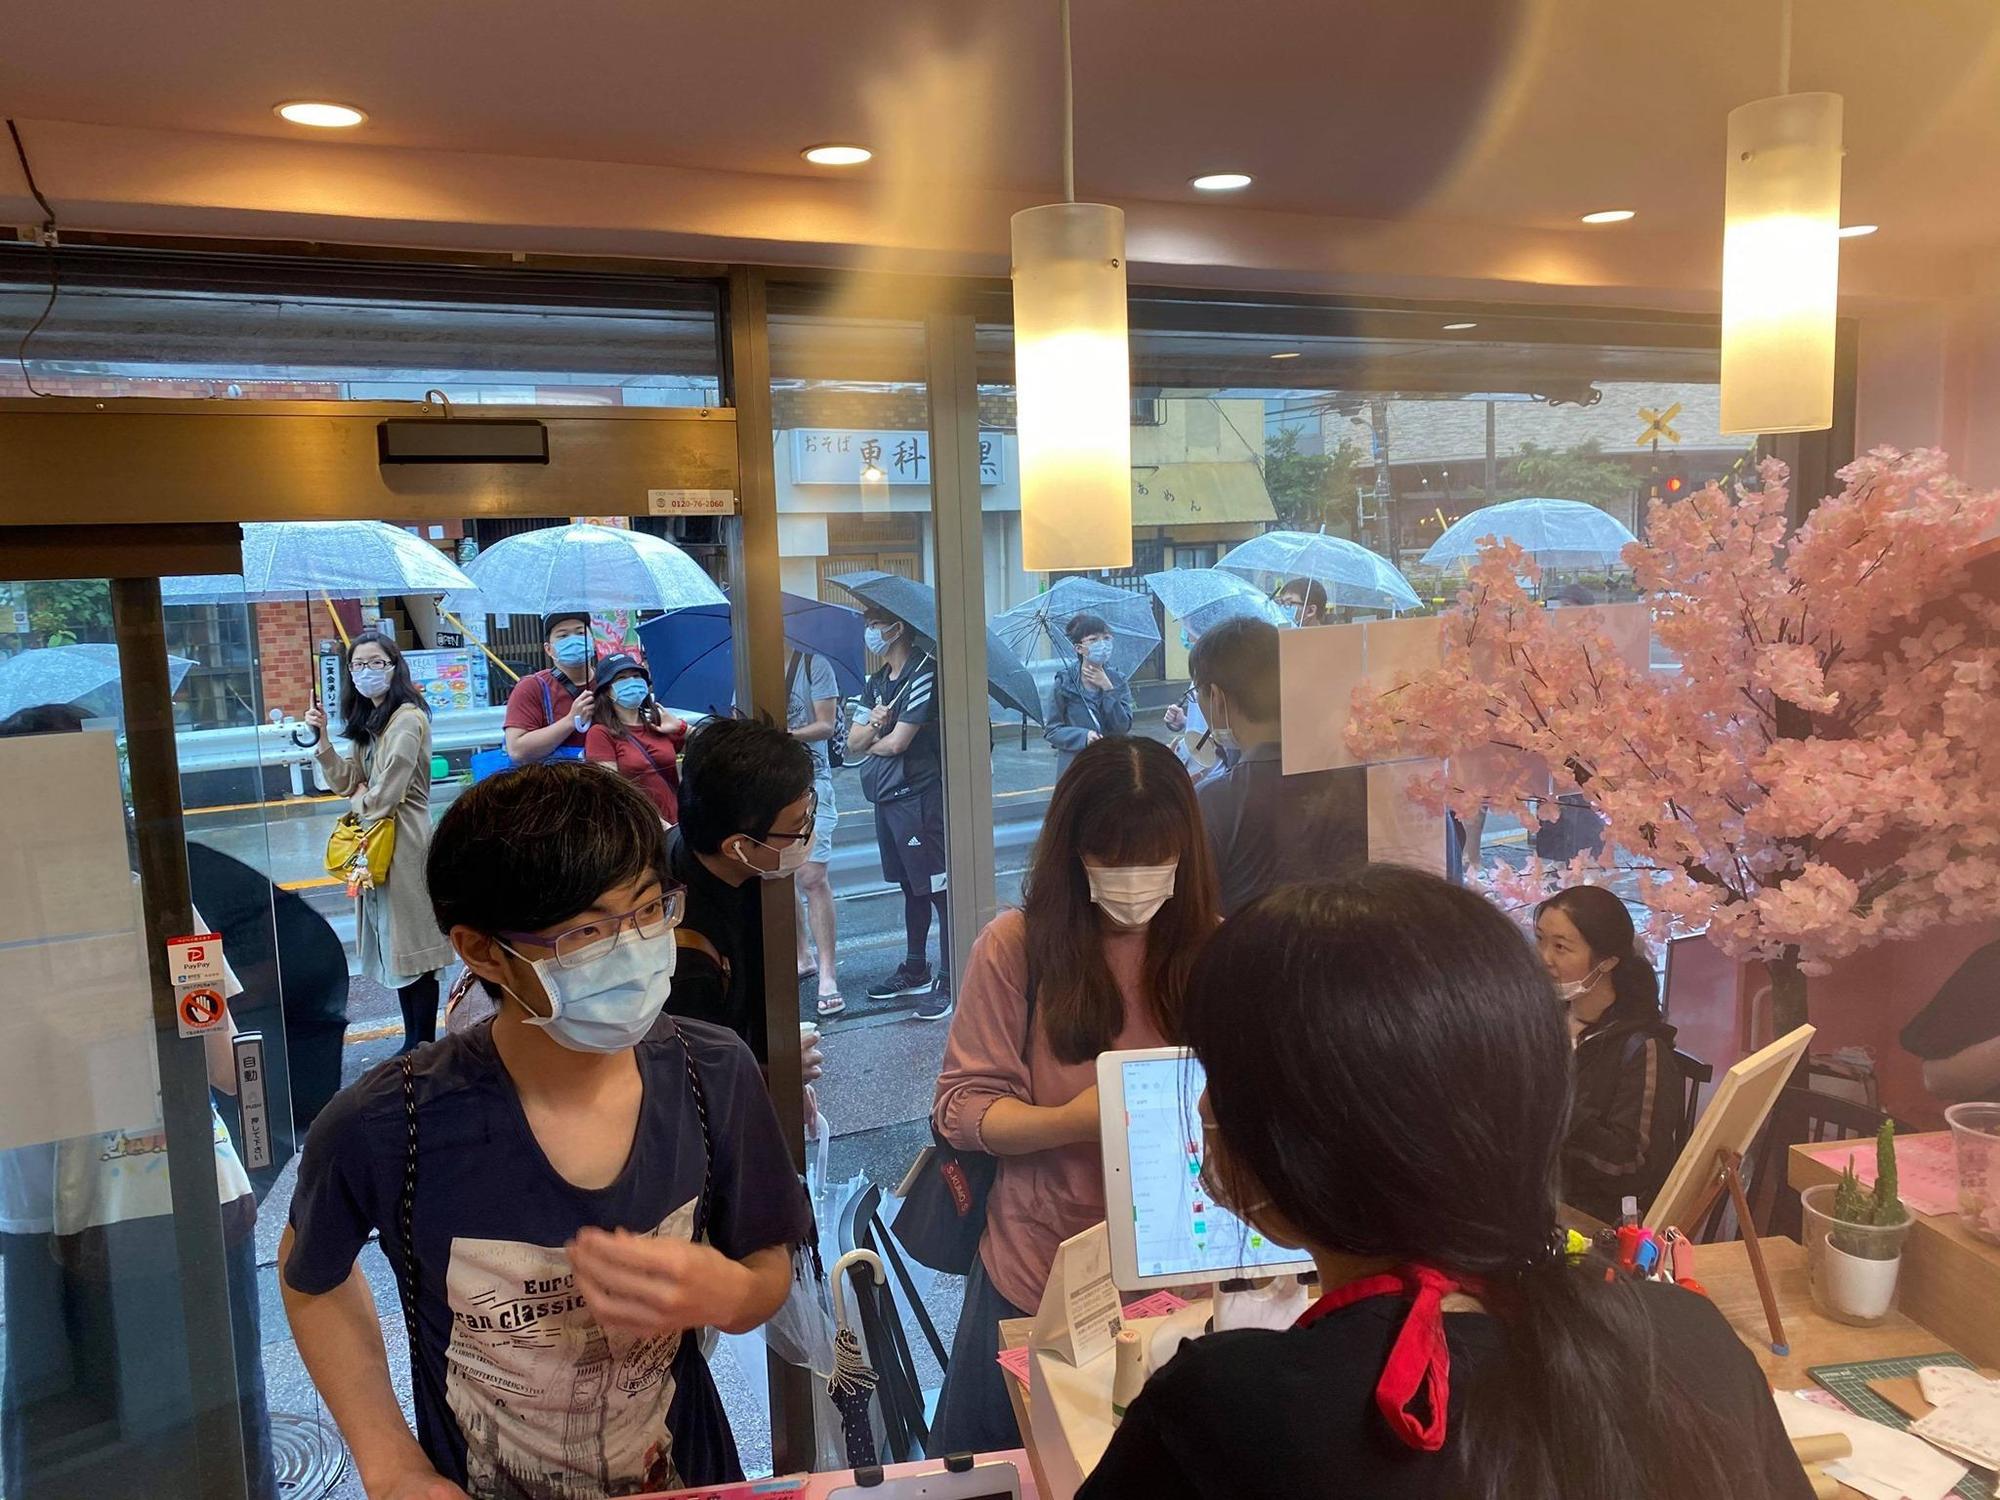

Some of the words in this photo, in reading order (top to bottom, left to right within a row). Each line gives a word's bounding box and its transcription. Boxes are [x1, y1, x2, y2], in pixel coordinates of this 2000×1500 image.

[804, 434, 852, 454] おそば
[183, 961, 210, 971] PayPay
[242, 1056, 258, 1083] 自動
